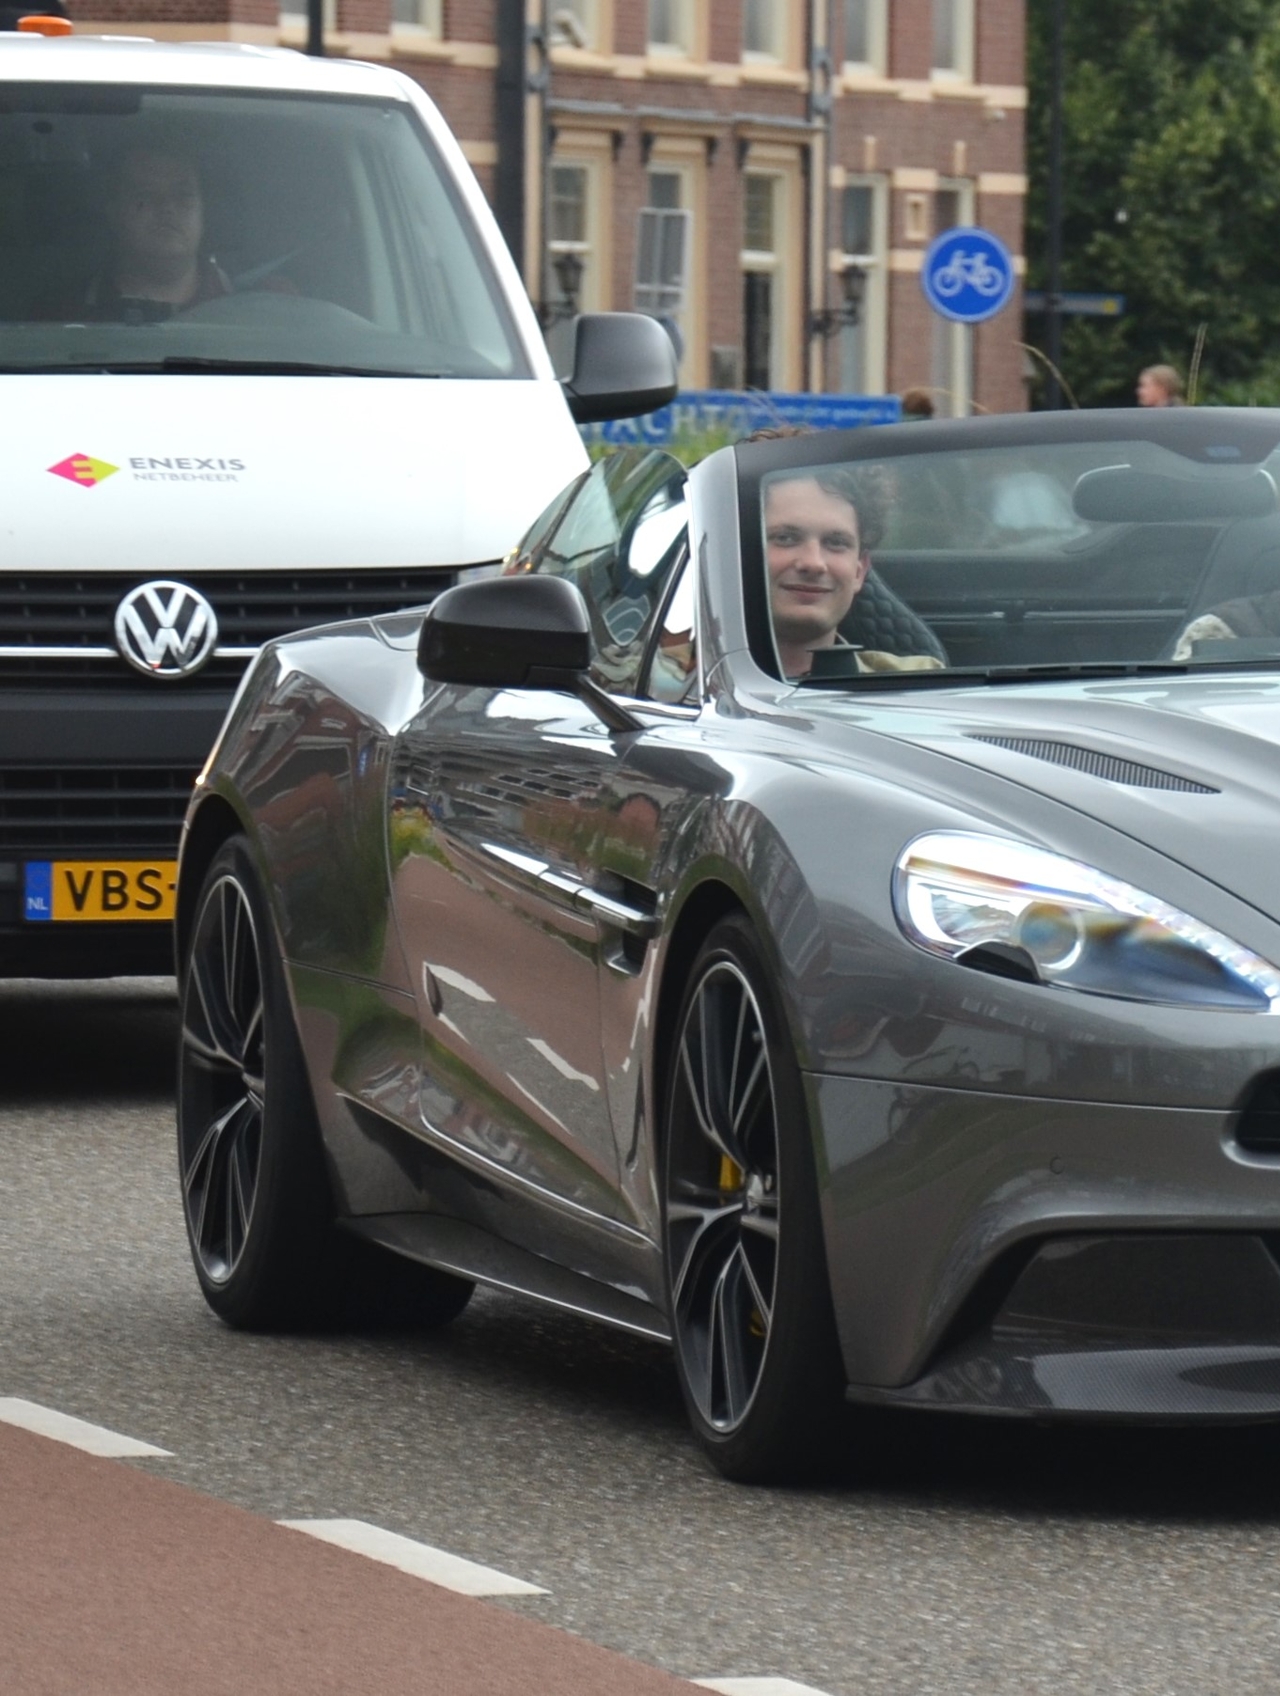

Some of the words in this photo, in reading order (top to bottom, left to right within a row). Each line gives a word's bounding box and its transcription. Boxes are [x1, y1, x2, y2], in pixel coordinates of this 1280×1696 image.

[129, 456, 246, 471] ENEXIS
[133, 472, 240, 483] NETBEHEER
[27, 897, 49, 911] NL
